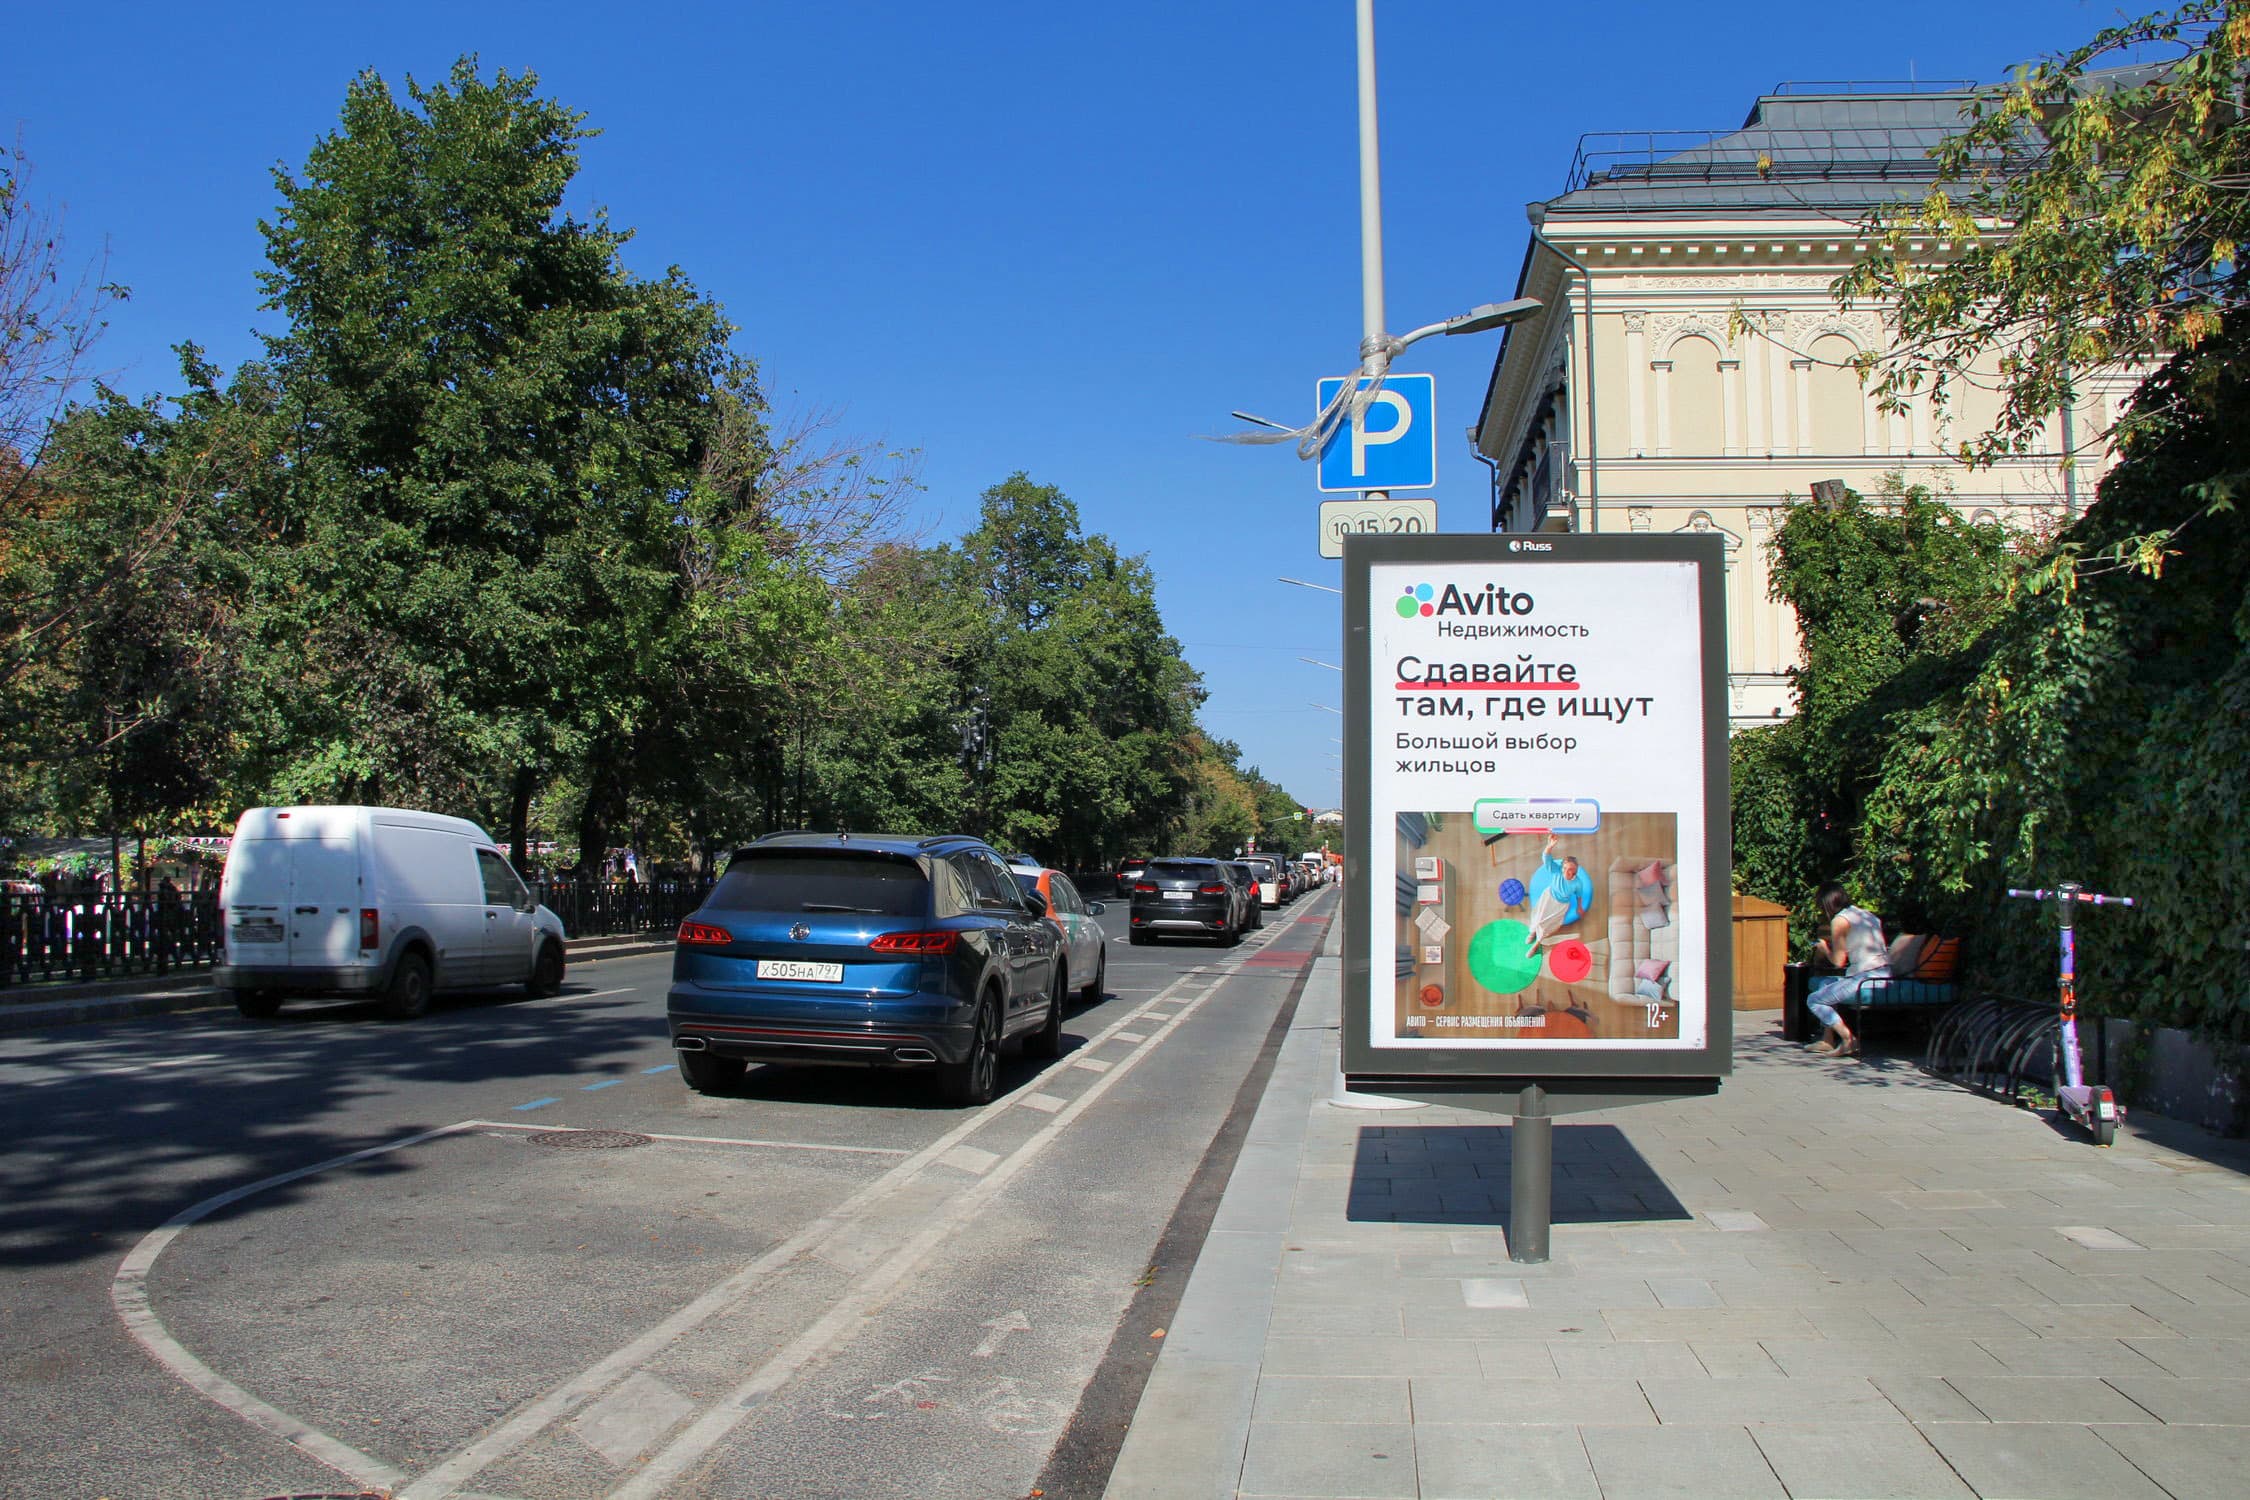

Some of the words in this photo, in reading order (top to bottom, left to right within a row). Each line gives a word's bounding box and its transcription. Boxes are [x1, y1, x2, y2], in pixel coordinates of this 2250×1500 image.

[1352, 390, 1412, 477] P
[1333, 522, 1350, 537] 10
[1522, 540, 1553, 551] Russ
[1436, 583, 1534, 616] Avito
[1438, 621, 1590, 640] Недвижимость
[1396, 654, 1577, 687] Сдавайте
[1396, 696, 1474, 721] там,
[1485, 696, 1546, 721] где
[1558, 696, 1654, 724] ищут
[1396, 731, 1499, 750] Большой
[1505, 732, 1577, 753] выбор
[1395, 759, 1497, 775] жильцов
[1492, 809, 1527, 820] Сдать
[1528, 811, 1581, 821] квартиру
[1406, 1015, 1426, 1027] АВИТО
[1435, 1015, 1460, 1027] СЕРВИС
[1460, 1015, 1503, 1028] РАЗМЕЩЕНИЯ
[1504, 1014, 1546, 1028] ОБЪЯВЛЕНИЙ
[1645, 1002, 1669, 1028] 12+
